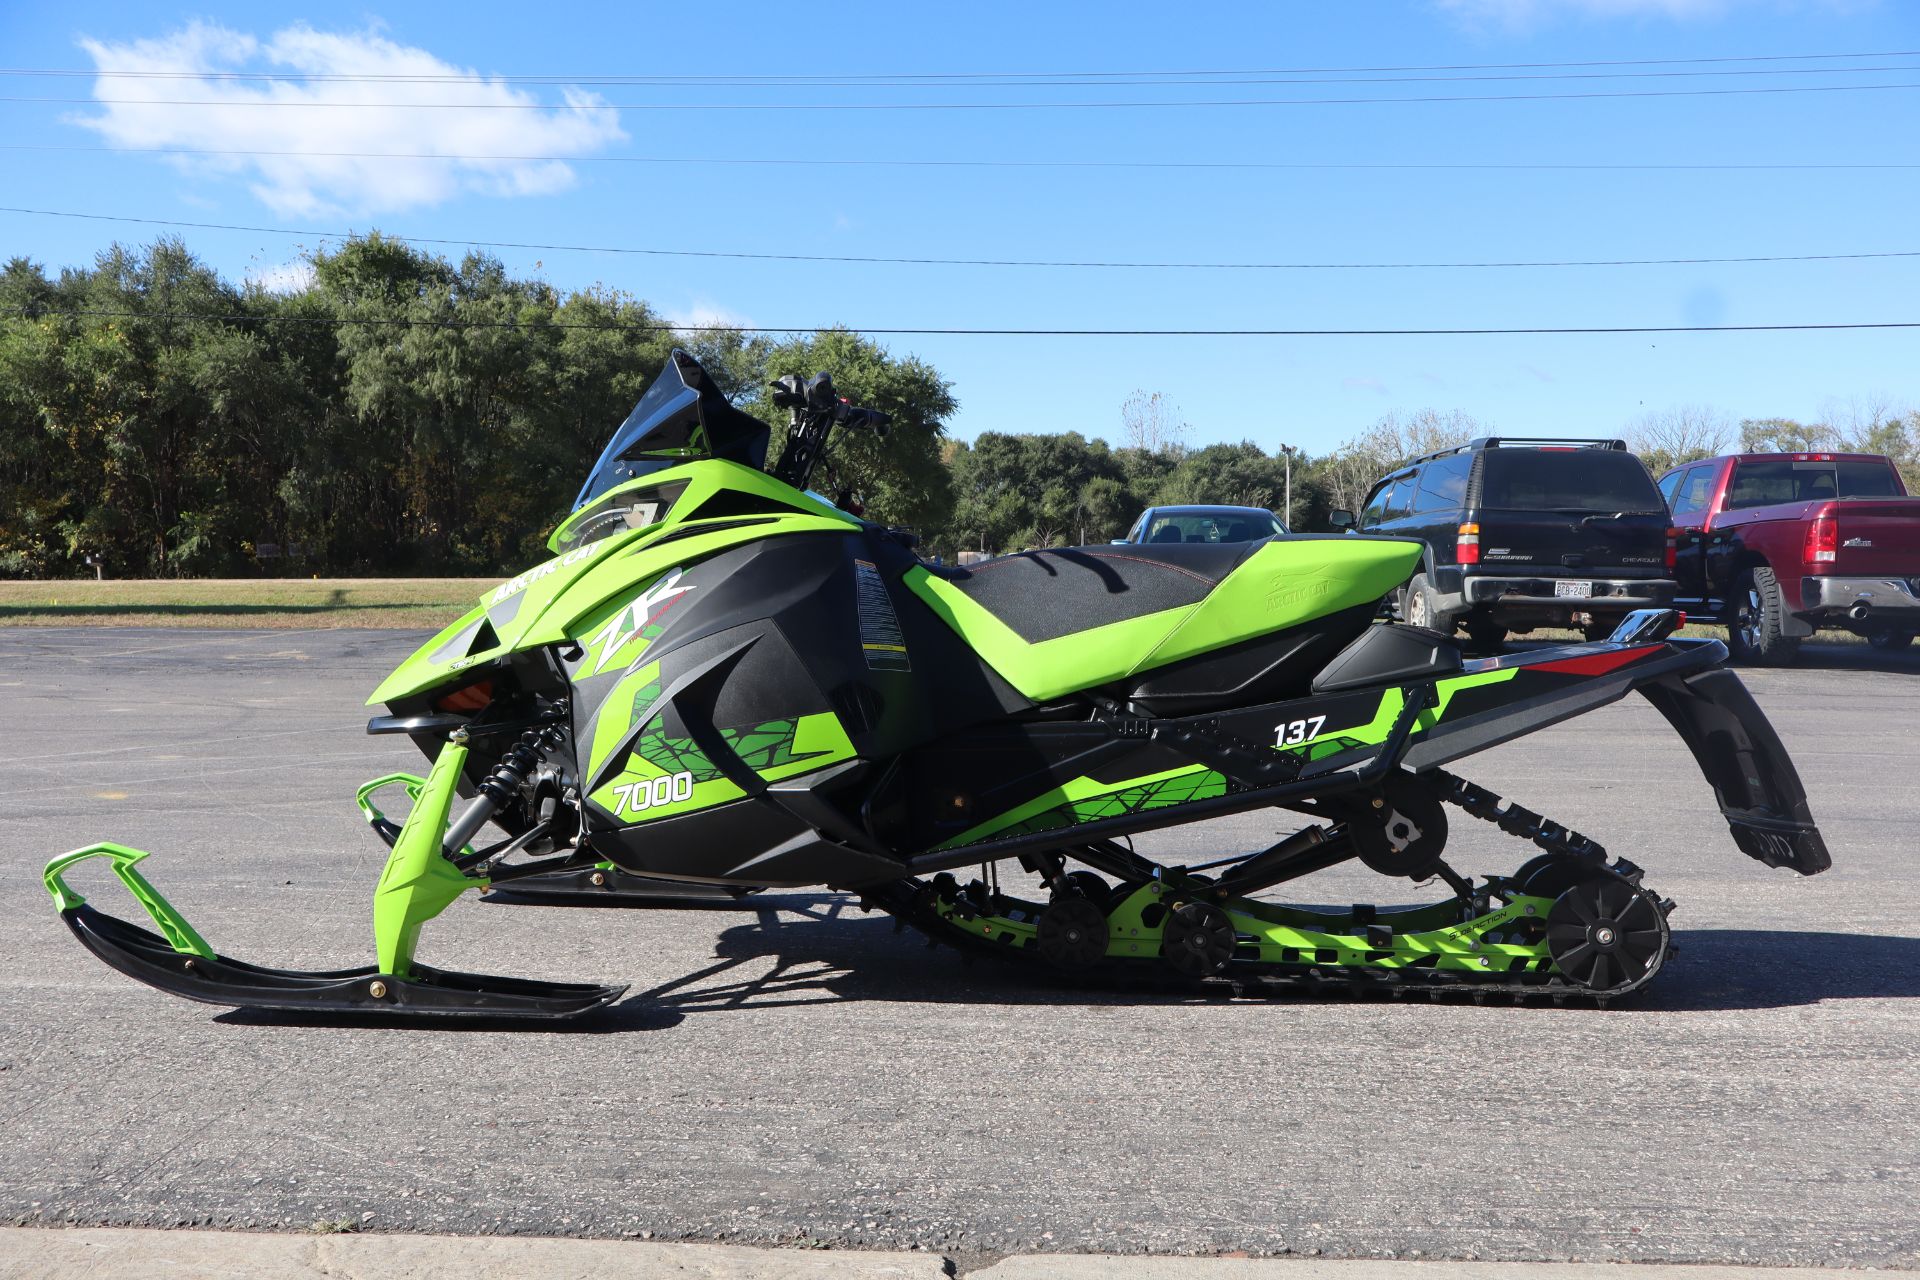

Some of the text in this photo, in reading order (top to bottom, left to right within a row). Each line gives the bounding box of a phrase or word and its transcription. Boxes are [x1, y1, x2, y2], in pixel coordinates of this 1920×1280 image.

[490, 539, 605, 606] ARCTIC CAT
[588, 567, 697, 676] ZR
[1274, 714, 1327, 748] 137
[612, 770, 693, 816] 7000
